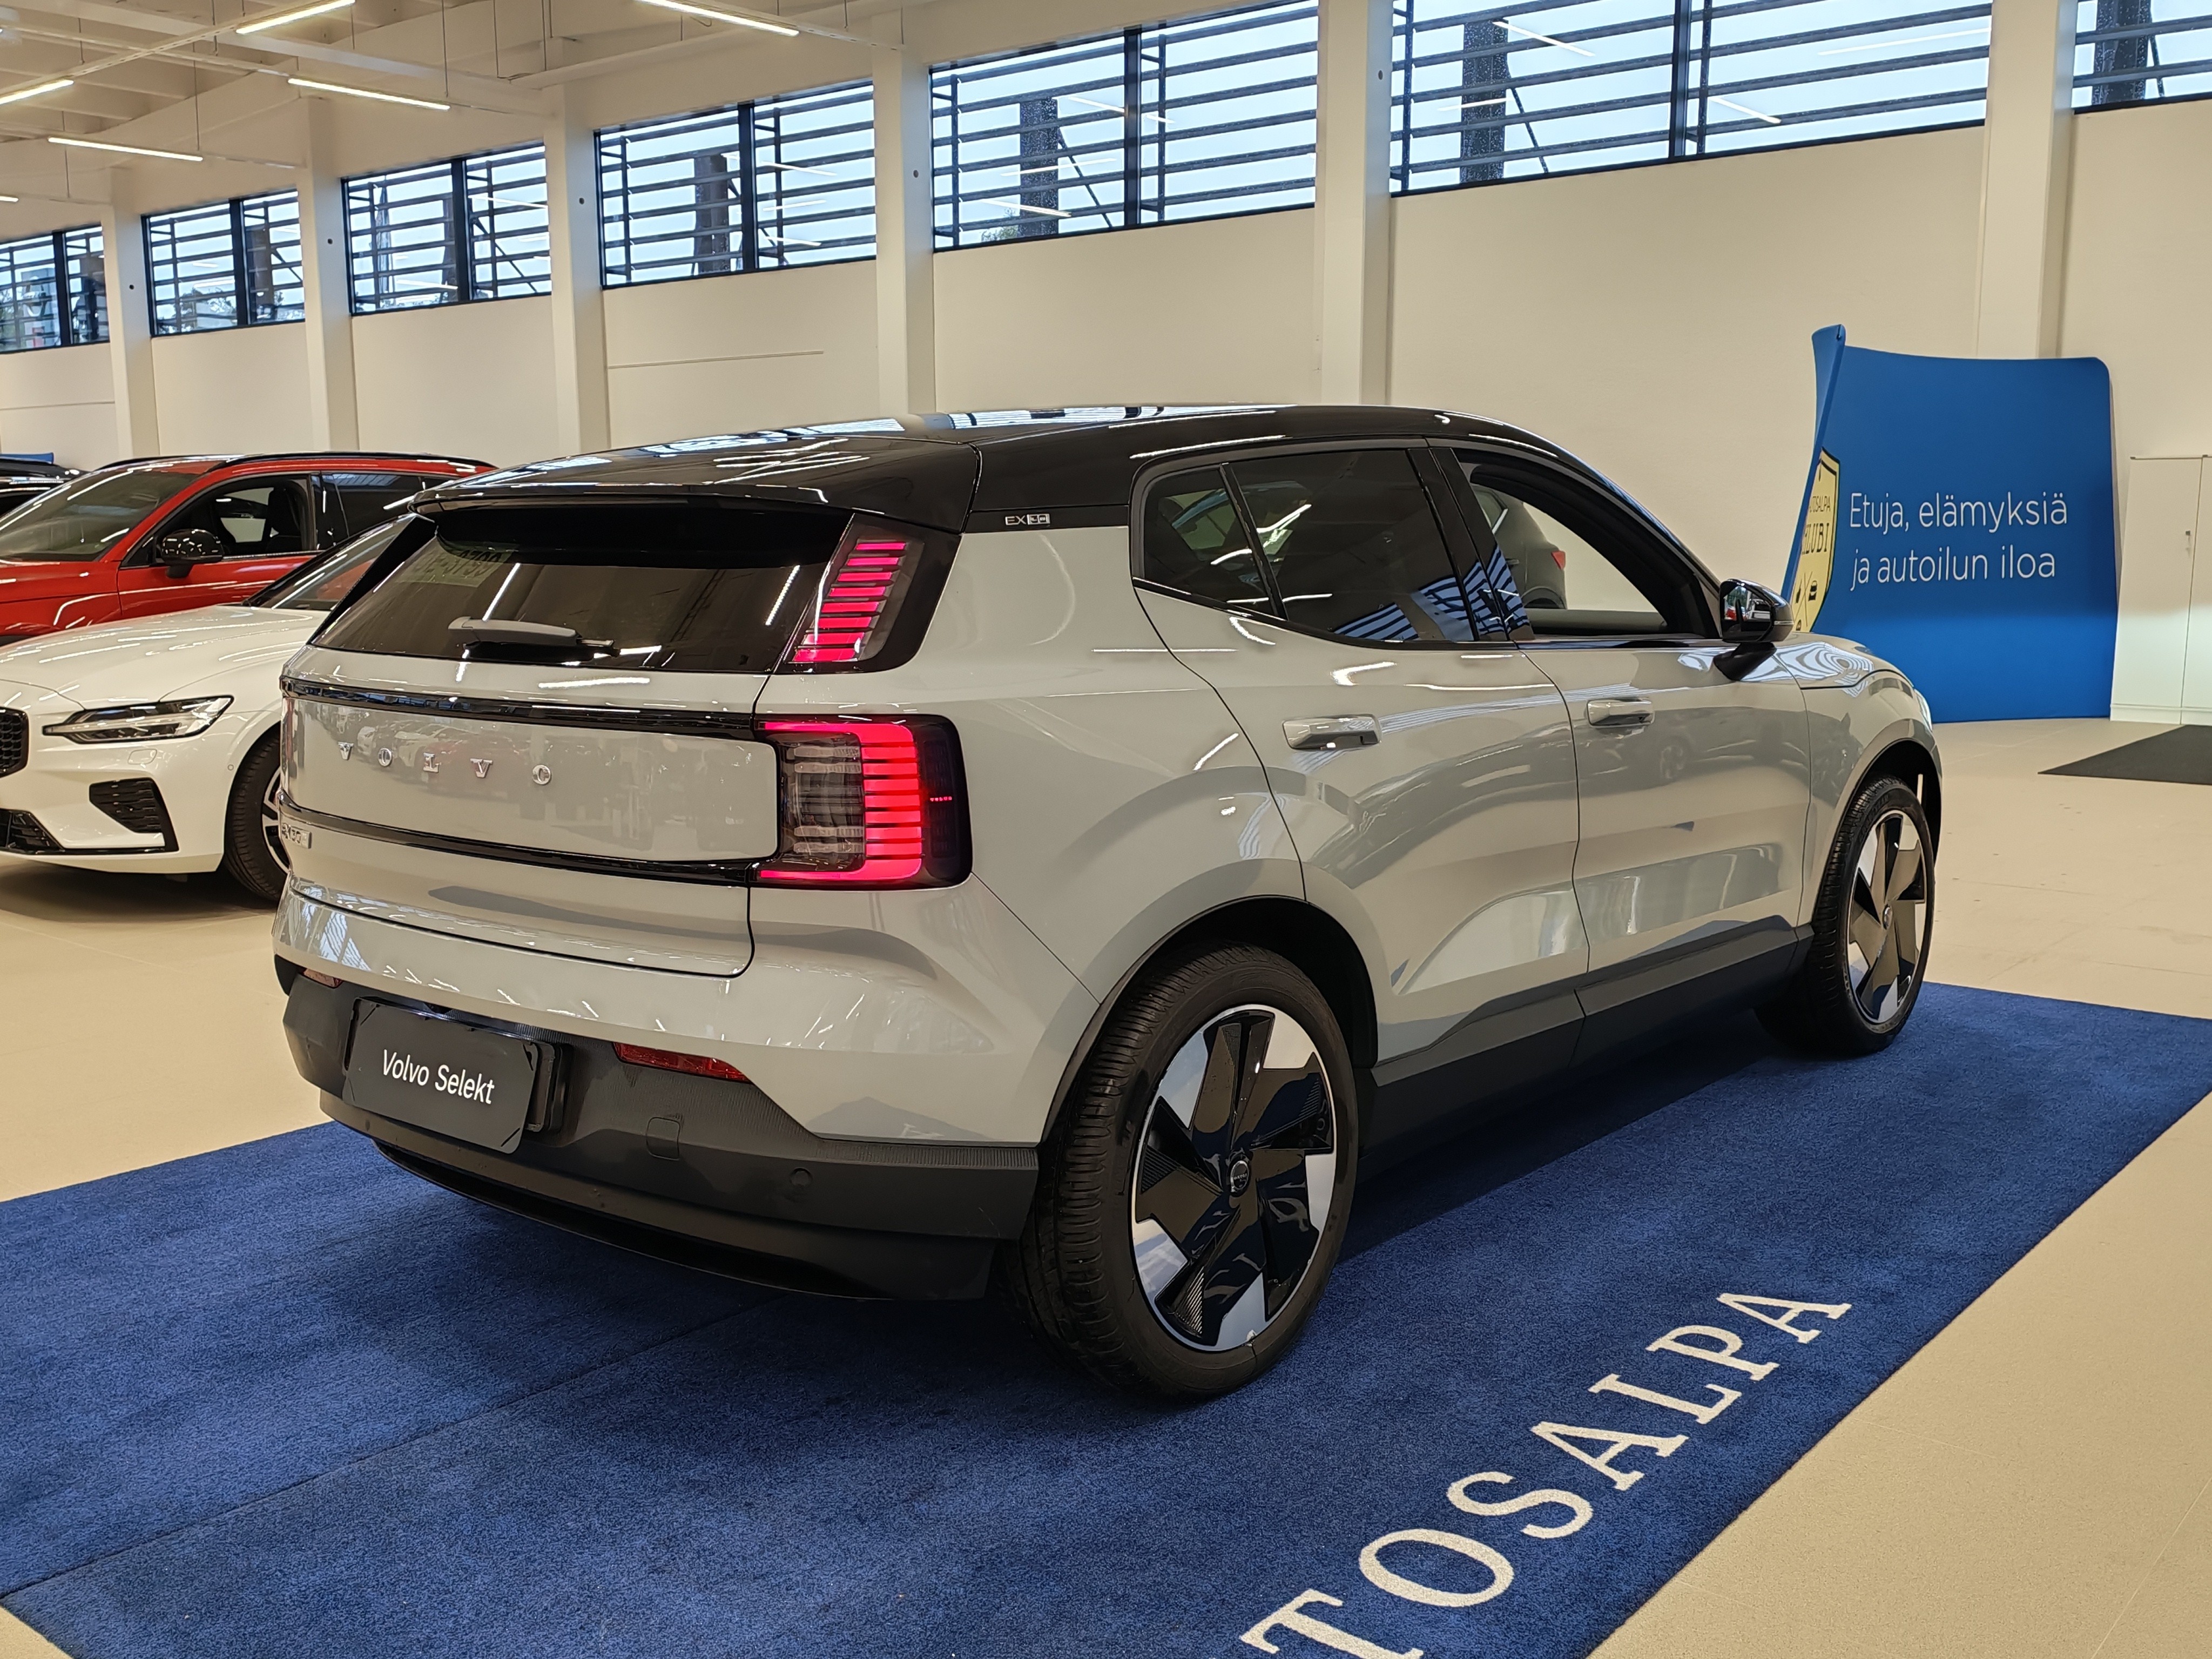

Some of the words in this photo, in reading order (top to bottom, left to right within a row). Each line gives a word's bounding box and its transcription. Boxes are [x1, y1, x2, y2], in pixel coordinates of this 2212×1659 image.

[1850, 493, 1909, 535] Etuja,
[1919, 491, 2067, 533] elämyksiä
[1850, 548, 1870, 591] ja
[1878, 546, 1987, 583] autoilun
[2001, 544, 2055, 579] iloa
[338, 741, 552, 785] VOLVO
[383, 1049, 429, 1086] Volvo
[435, 1064, 495, 1104] Selekt
[1237, 1291, 1852, 1659] TOSALPA
